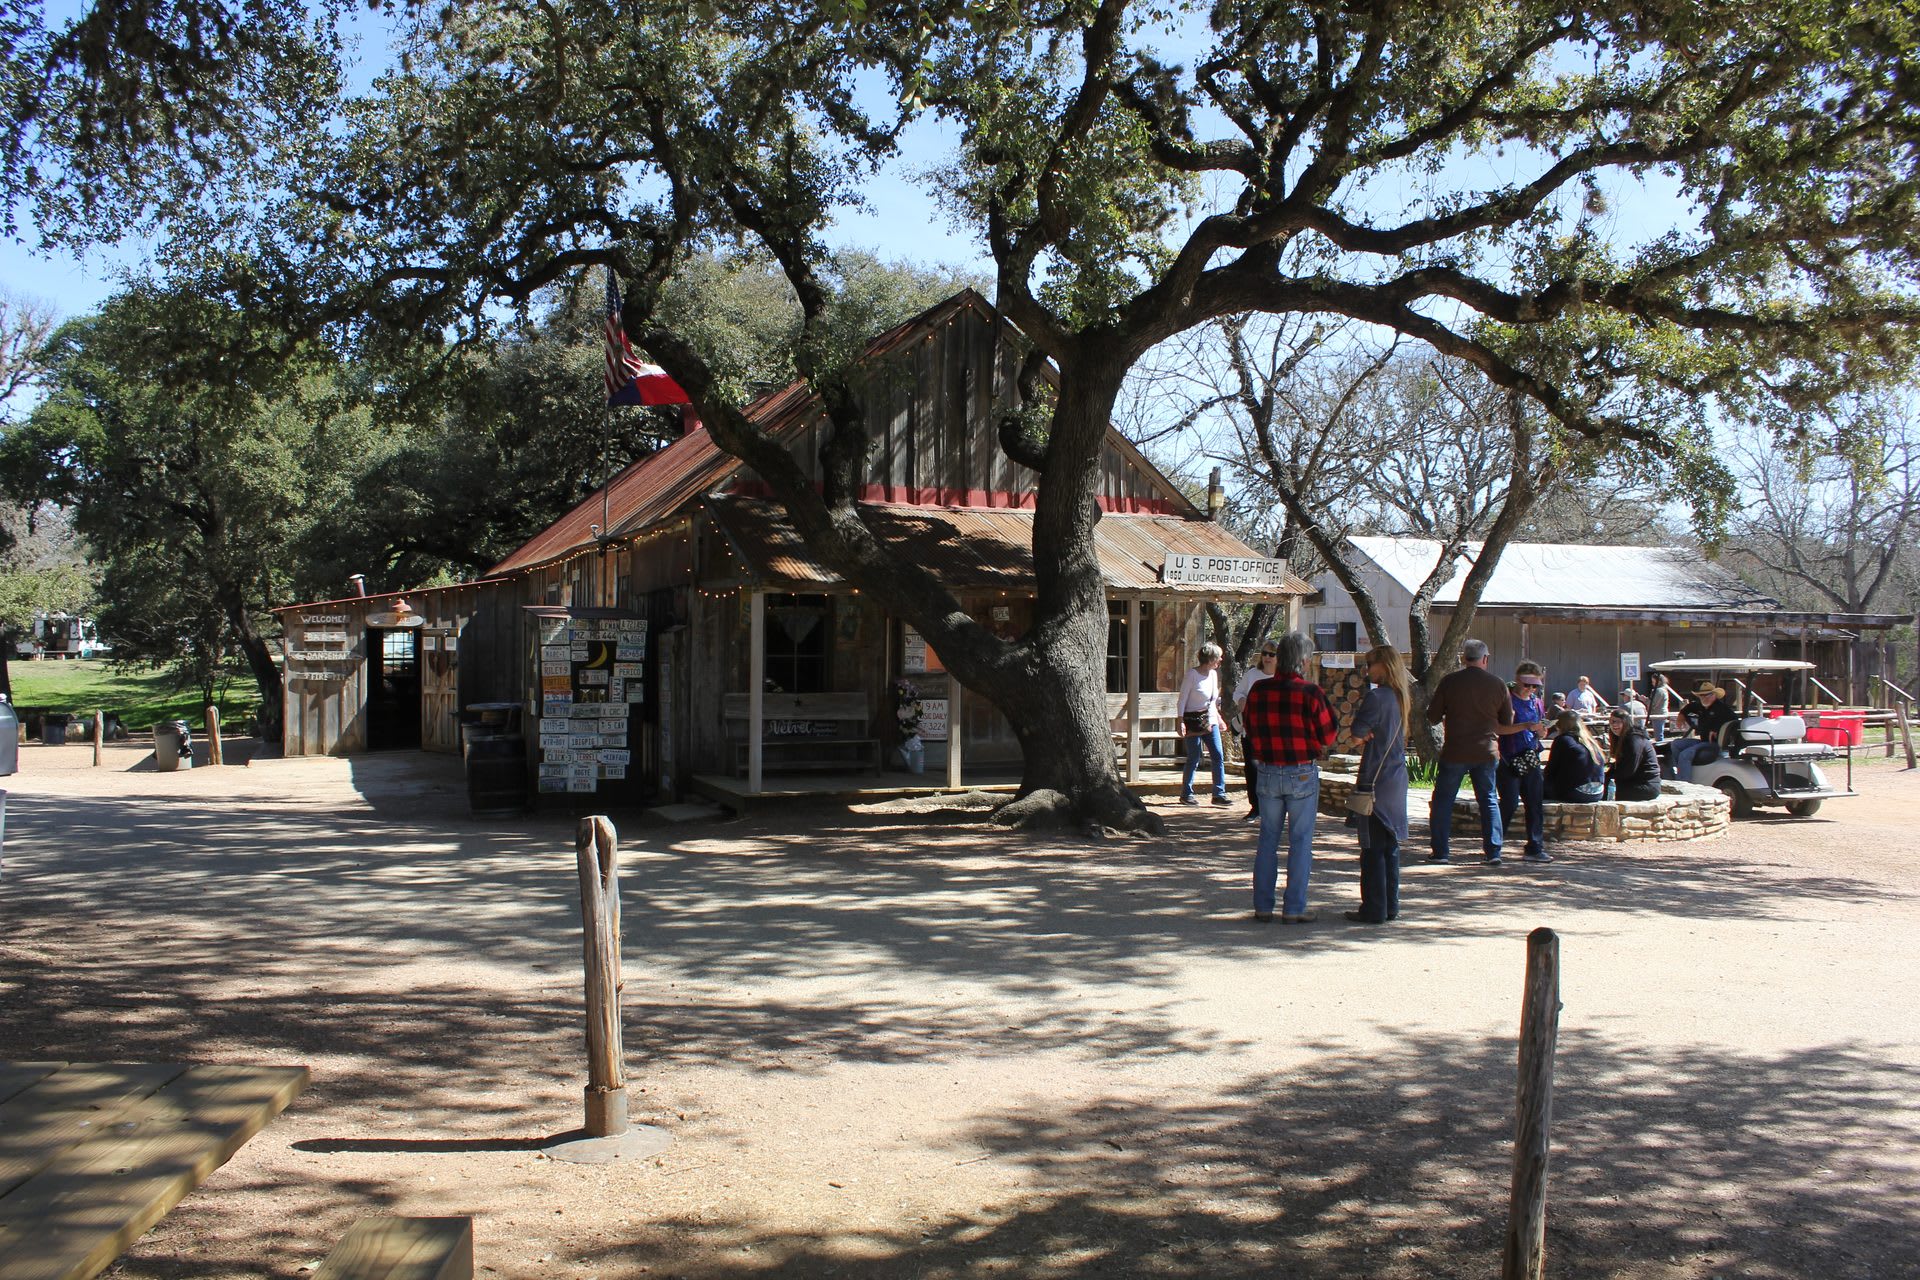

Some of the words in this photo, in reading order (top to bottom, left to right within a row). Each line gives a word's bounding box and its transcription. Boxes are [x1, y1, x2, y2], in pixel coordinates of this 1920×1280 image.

[1175, 556, 1188, 568] U.
[1192, 557, 1203, 569] S.
[1208, 558, 1279, 574] POST-OFFICE
[300, 615, 346, 624] WELCOME!
[574, 631, 585, 640] MZ
[602, 631, 617, 640] 444
